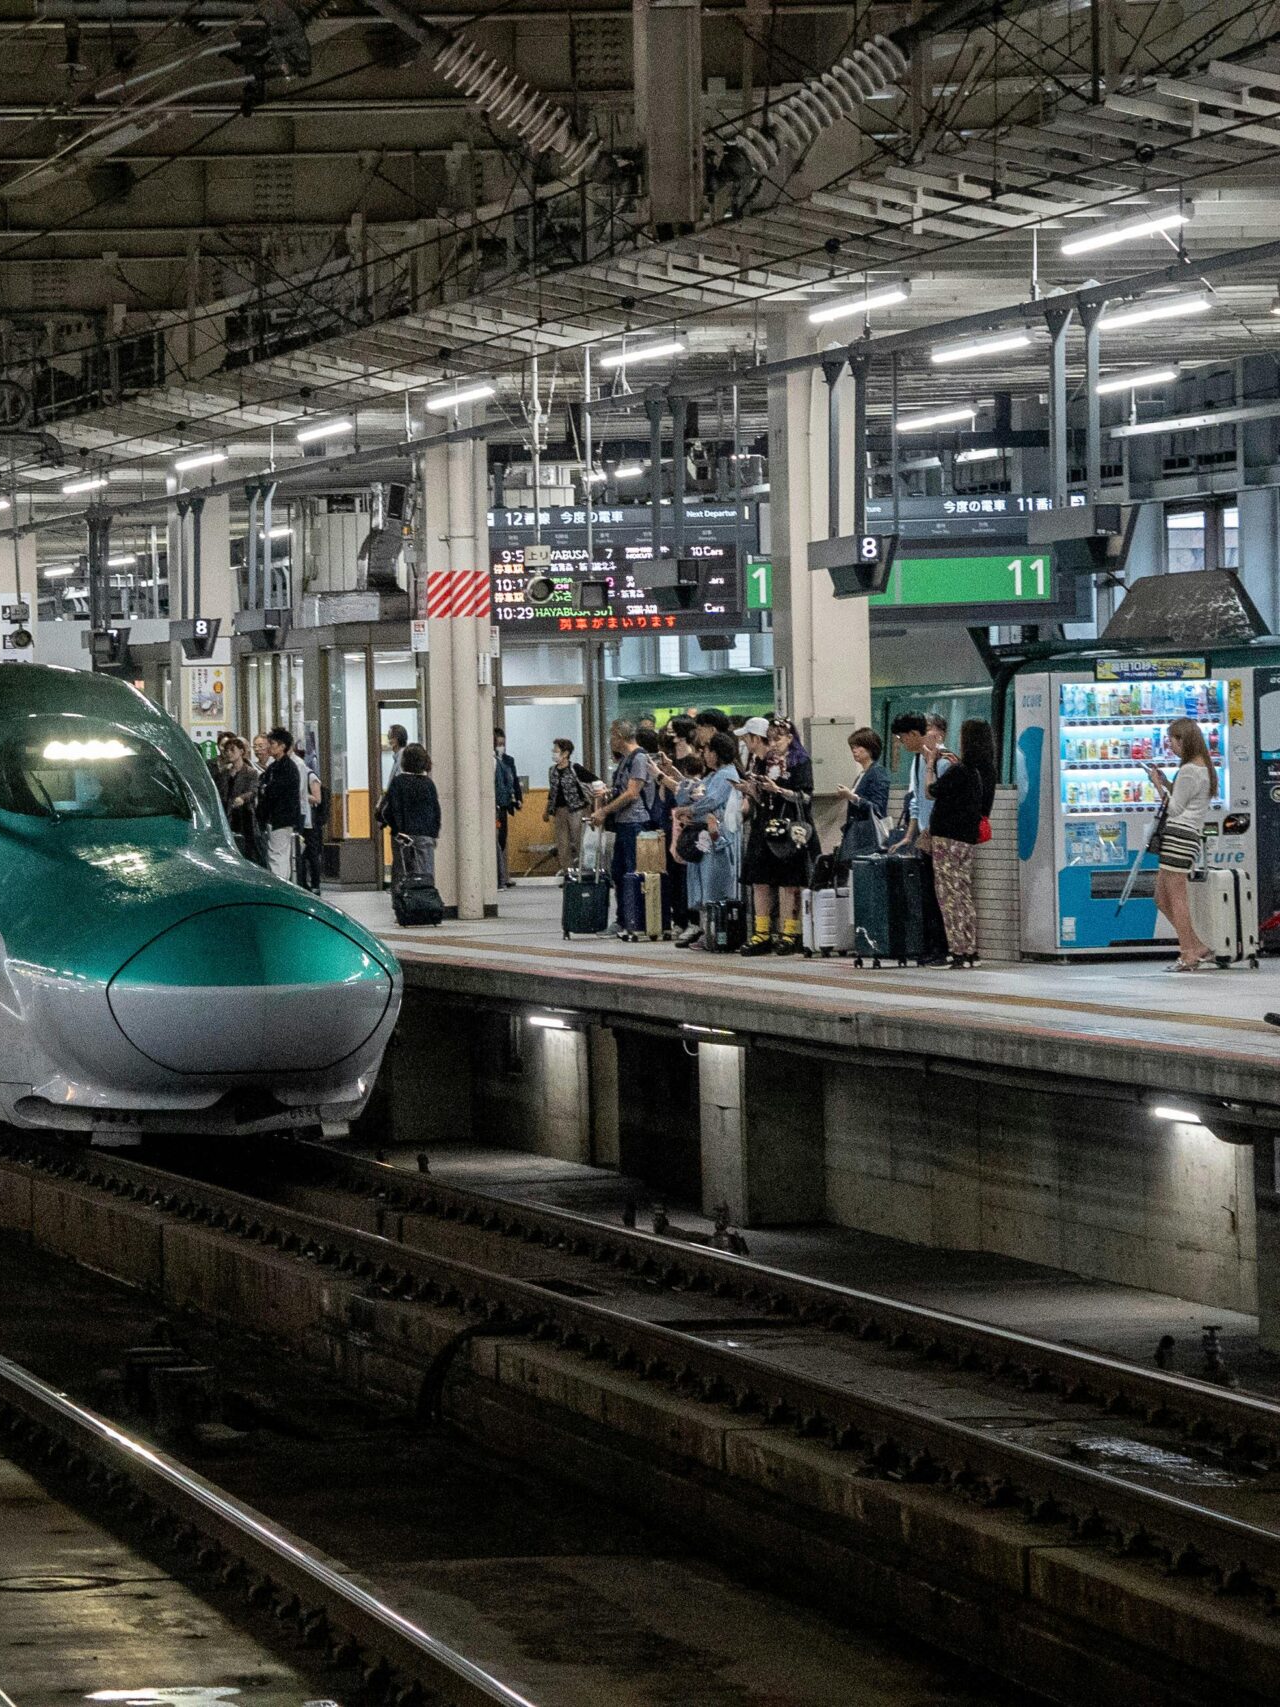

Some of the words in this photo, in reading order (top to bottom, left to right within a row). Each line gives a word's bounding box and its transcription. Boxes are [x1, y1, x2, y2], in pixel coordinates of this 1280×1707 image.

[944, 500, 1006, 514] 今度の電車
[501, 550, 524, 563] 9:5
[550, 549, 589, 560] YABUSA
[605, 548, 613, 559] 7
[690, 546, 702, 556] 10
[703, 546, 724, 556] Cars
[862, 537, 877, 558] 8
[527, 550, 549, 561] 上り
[708, 576, 724, 585] ars
[1007, 559, 1044, 596] 11
[496, 579, 528, 591] 10:1
[496, 607, 534, 620] 10:29
[195, 620, 207, 635] 8
[560, 616, 676, 630] 列車がまいります
